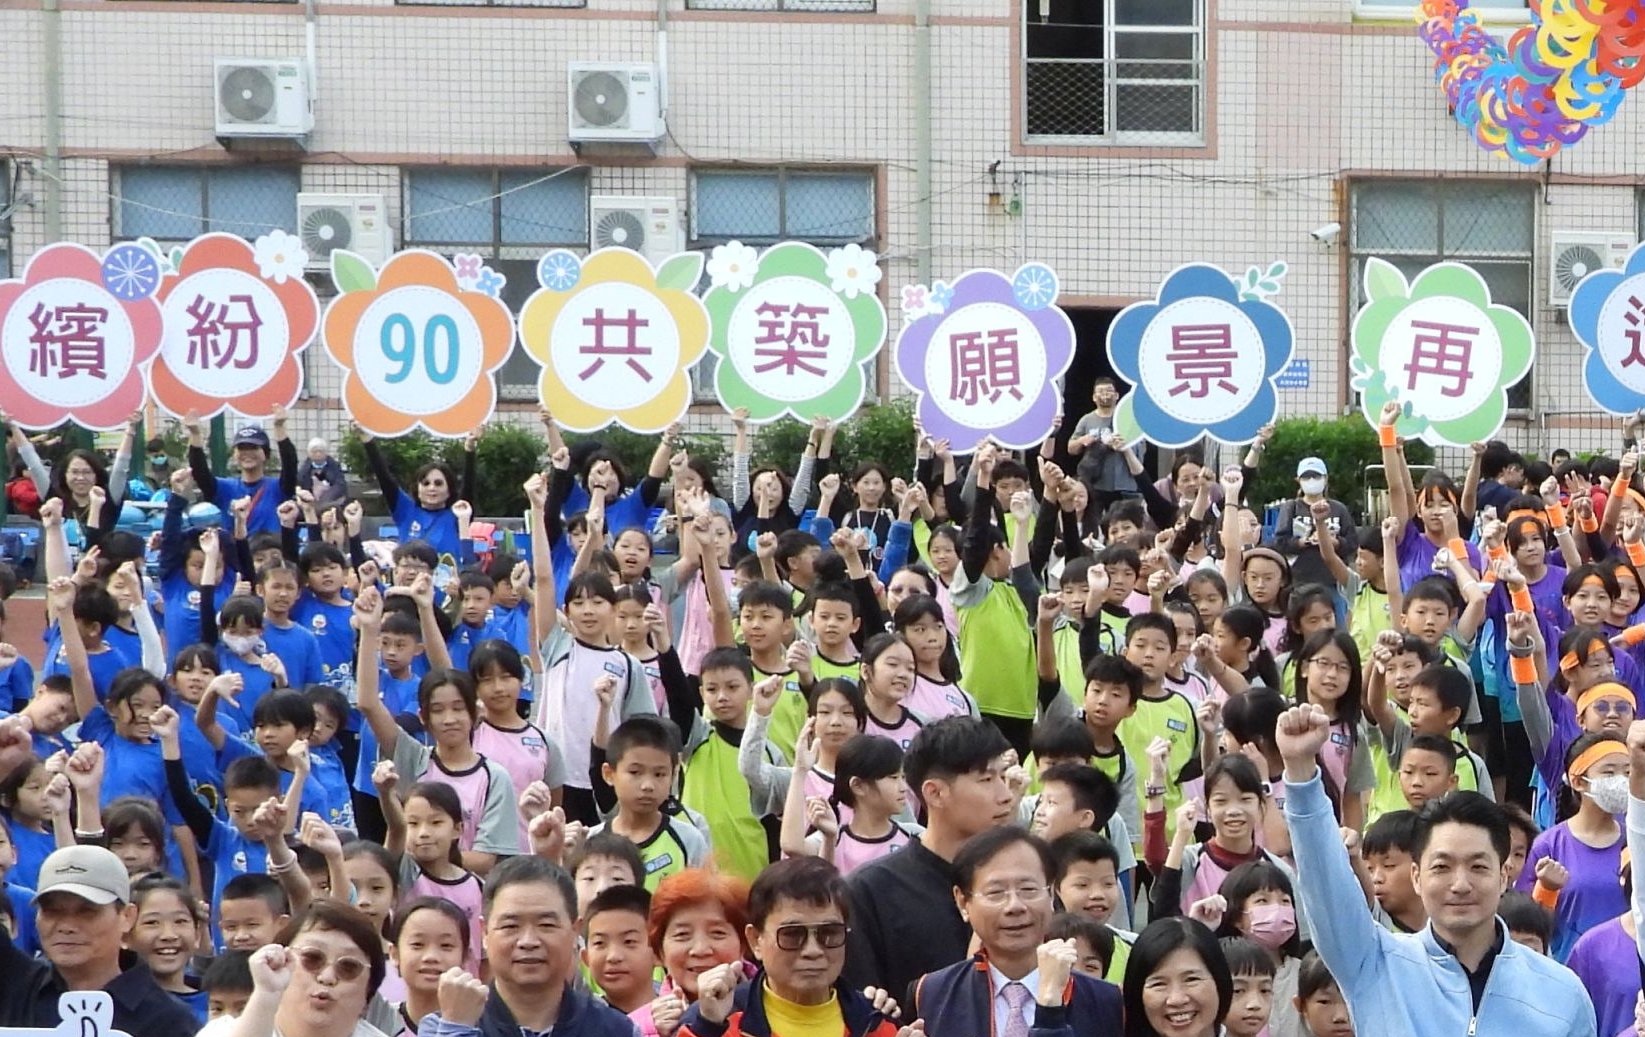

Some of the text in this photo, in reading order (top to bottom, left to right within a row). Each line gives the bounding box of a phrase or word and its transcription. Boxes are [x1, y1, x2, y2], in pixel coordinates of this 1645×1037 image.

[29, 304, 109, 378] 繽
[187, 295, 261, 370] 紛
[379, 313, 460, 385] 90
[579, 308, 653, 382] 共
[754, 300, 830, 377] 築
[949, 327, 1022, 406] 願
[1165, 323, 1240, 400] 景
[1403, 320, 1482, 398] 再
